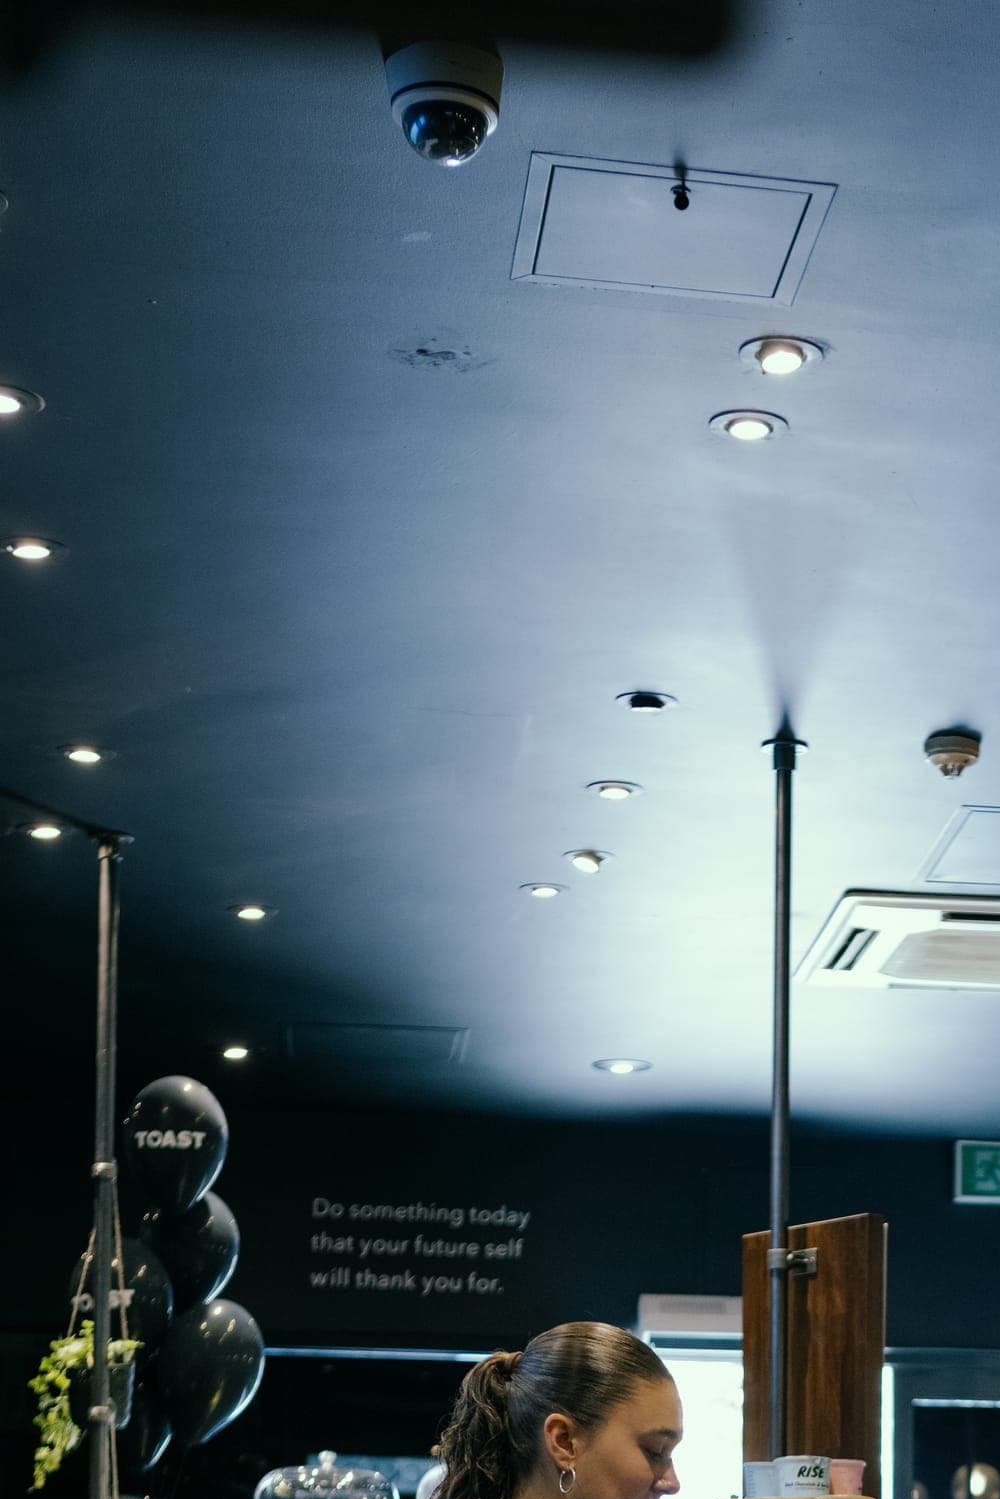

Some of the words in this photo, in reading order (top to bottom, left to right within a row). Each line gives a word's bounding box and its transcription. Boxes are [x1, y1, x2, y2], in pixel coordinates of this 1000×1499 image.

[134, 1130, 207, 1149] TOAST
[312, 1198, 345, 1218] Do
[349, 1202, 465, 1228] something
[468, 1206, 531, 1231] today
[311, 1232, 354, 1252] that
[359, 1238, 409, 1259] your
[413, 1235, 480, 1257] future
[484, 1238, 524, 1258] self
[310, 1267, 350, 1288] will
[355, 1269, 416, 1290] thank
[421, 1275, 463, 1296] you
[467, 1272, 505, 1293] for.
[797, 1465, 825, 1478] RISE
